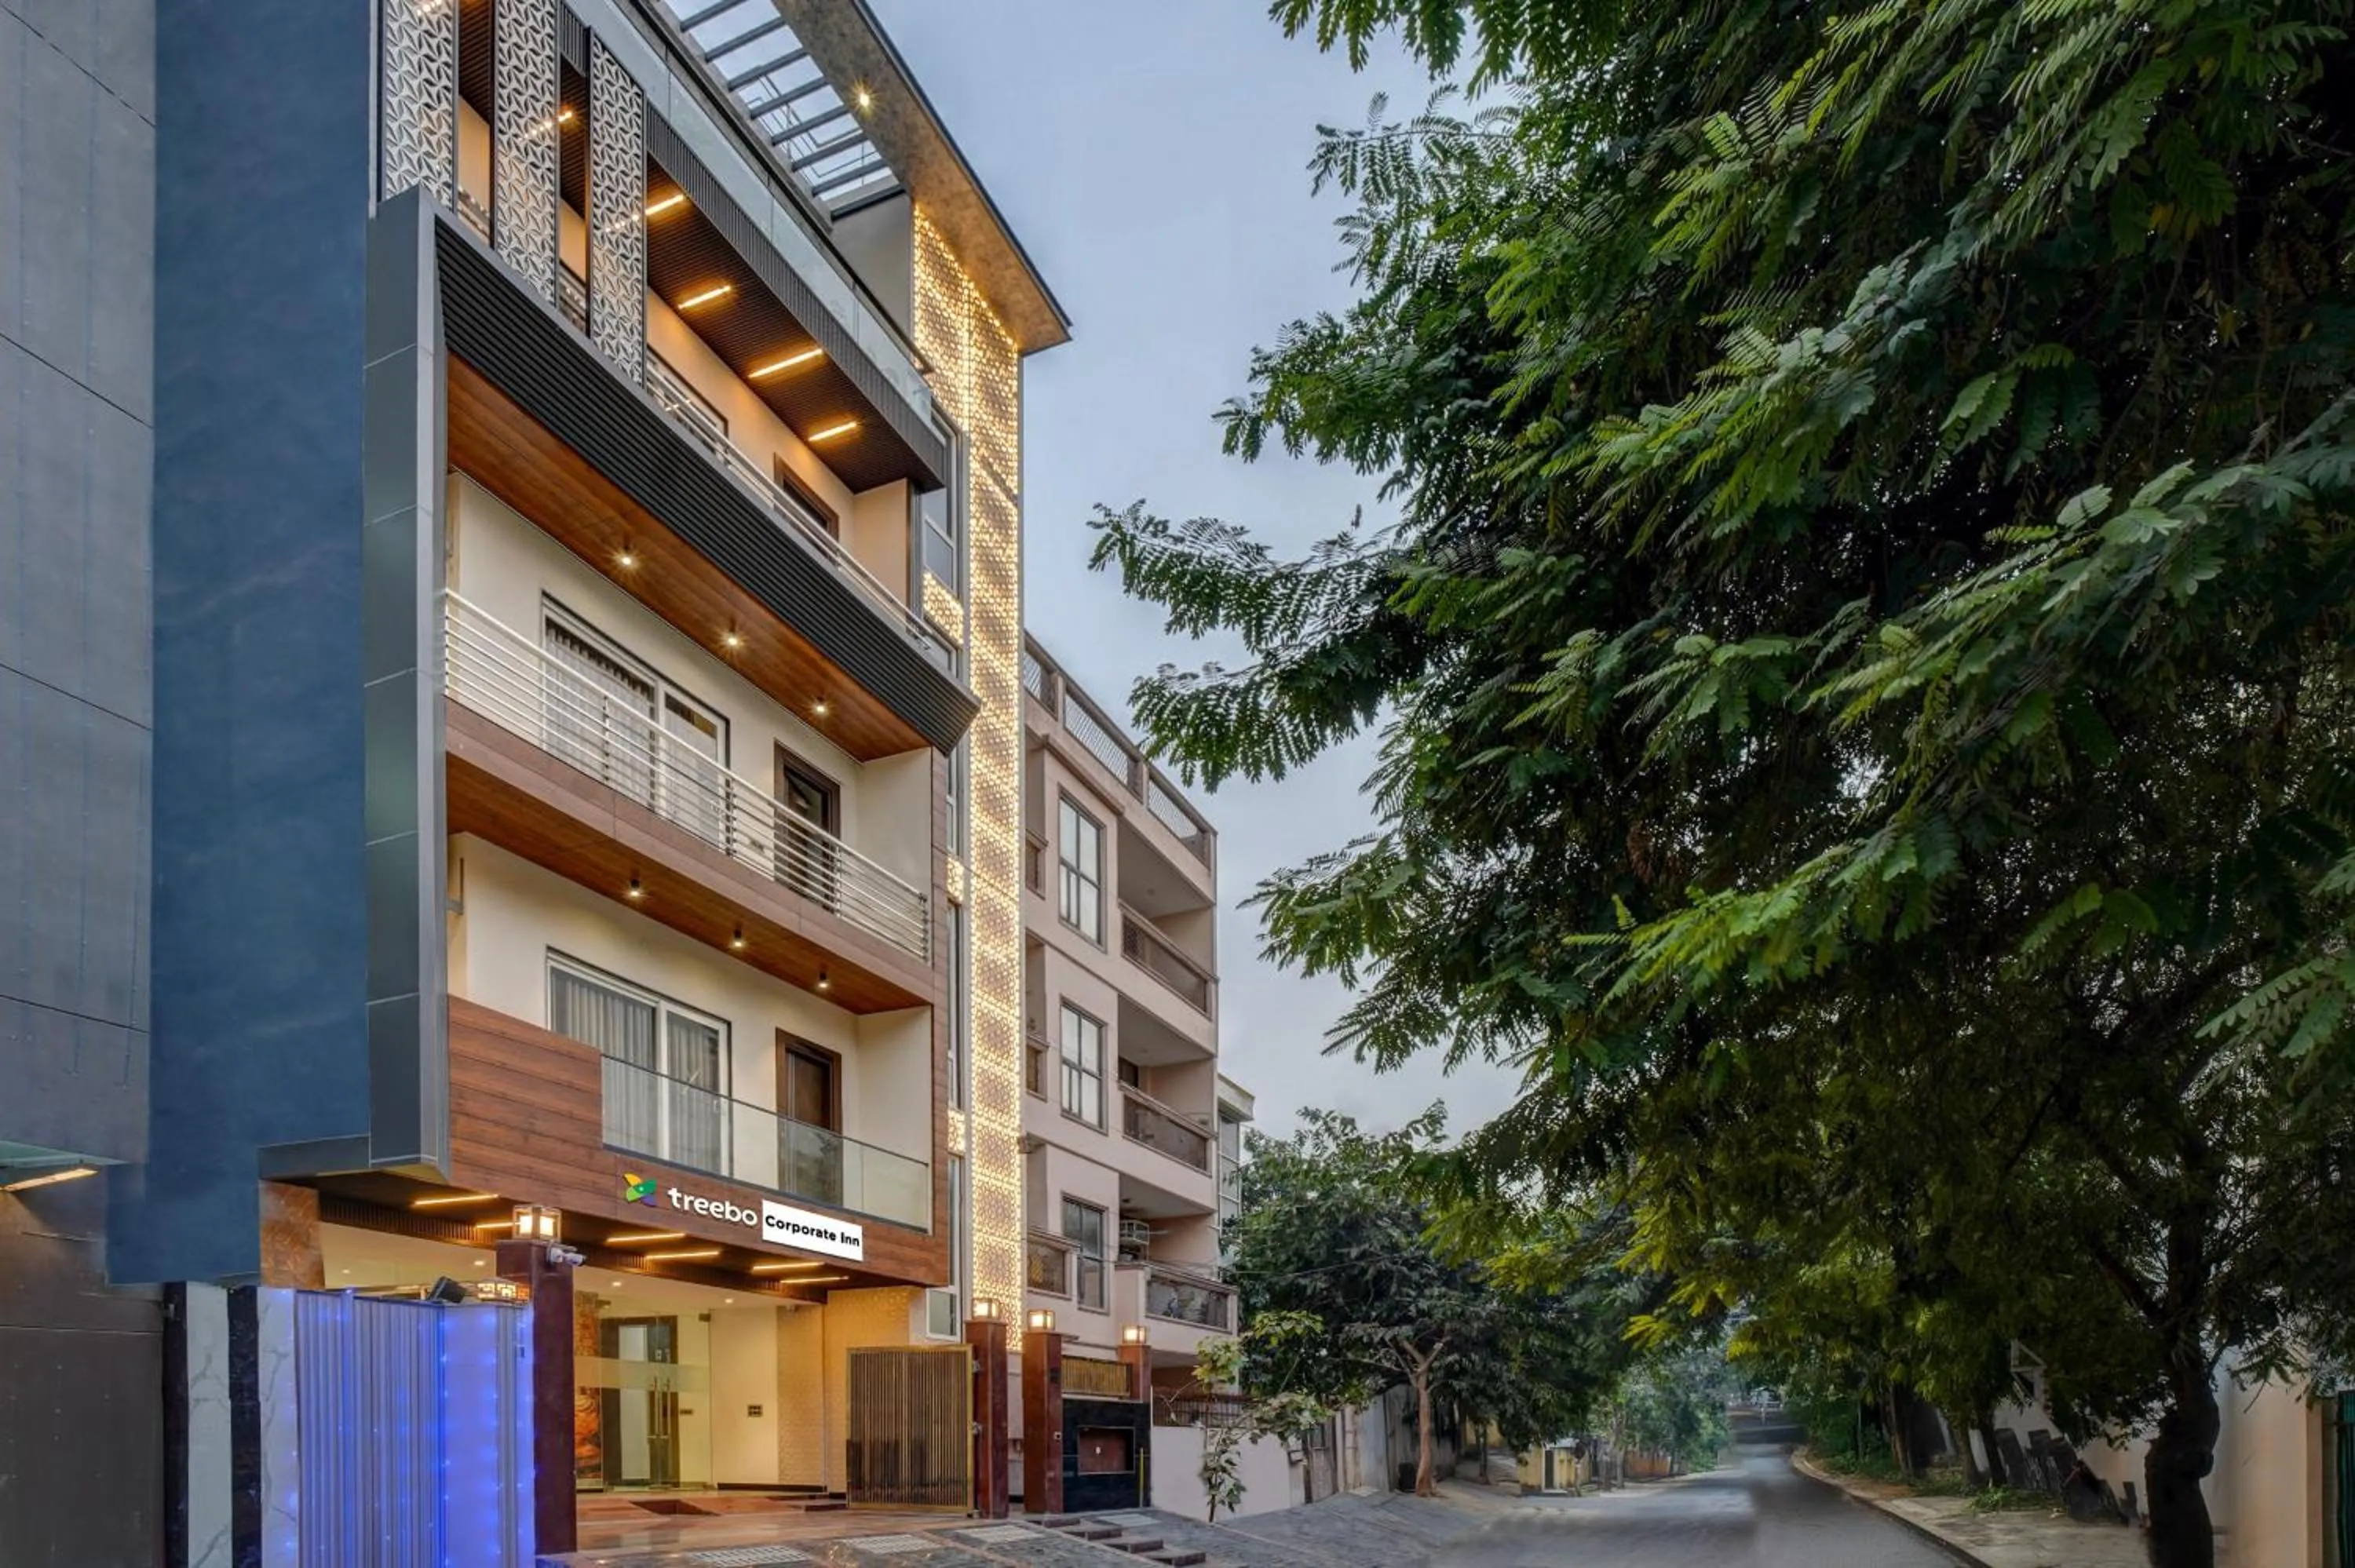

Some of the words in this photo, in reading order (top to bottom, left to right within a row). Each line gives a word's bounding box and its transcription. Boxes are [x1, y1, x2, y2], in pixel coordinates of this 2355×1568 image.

[666, 1187, 758, 1226] treebo
[765, 1215, 837, 1242] Corporate
[840, 1231, 860, 1247] Inn
